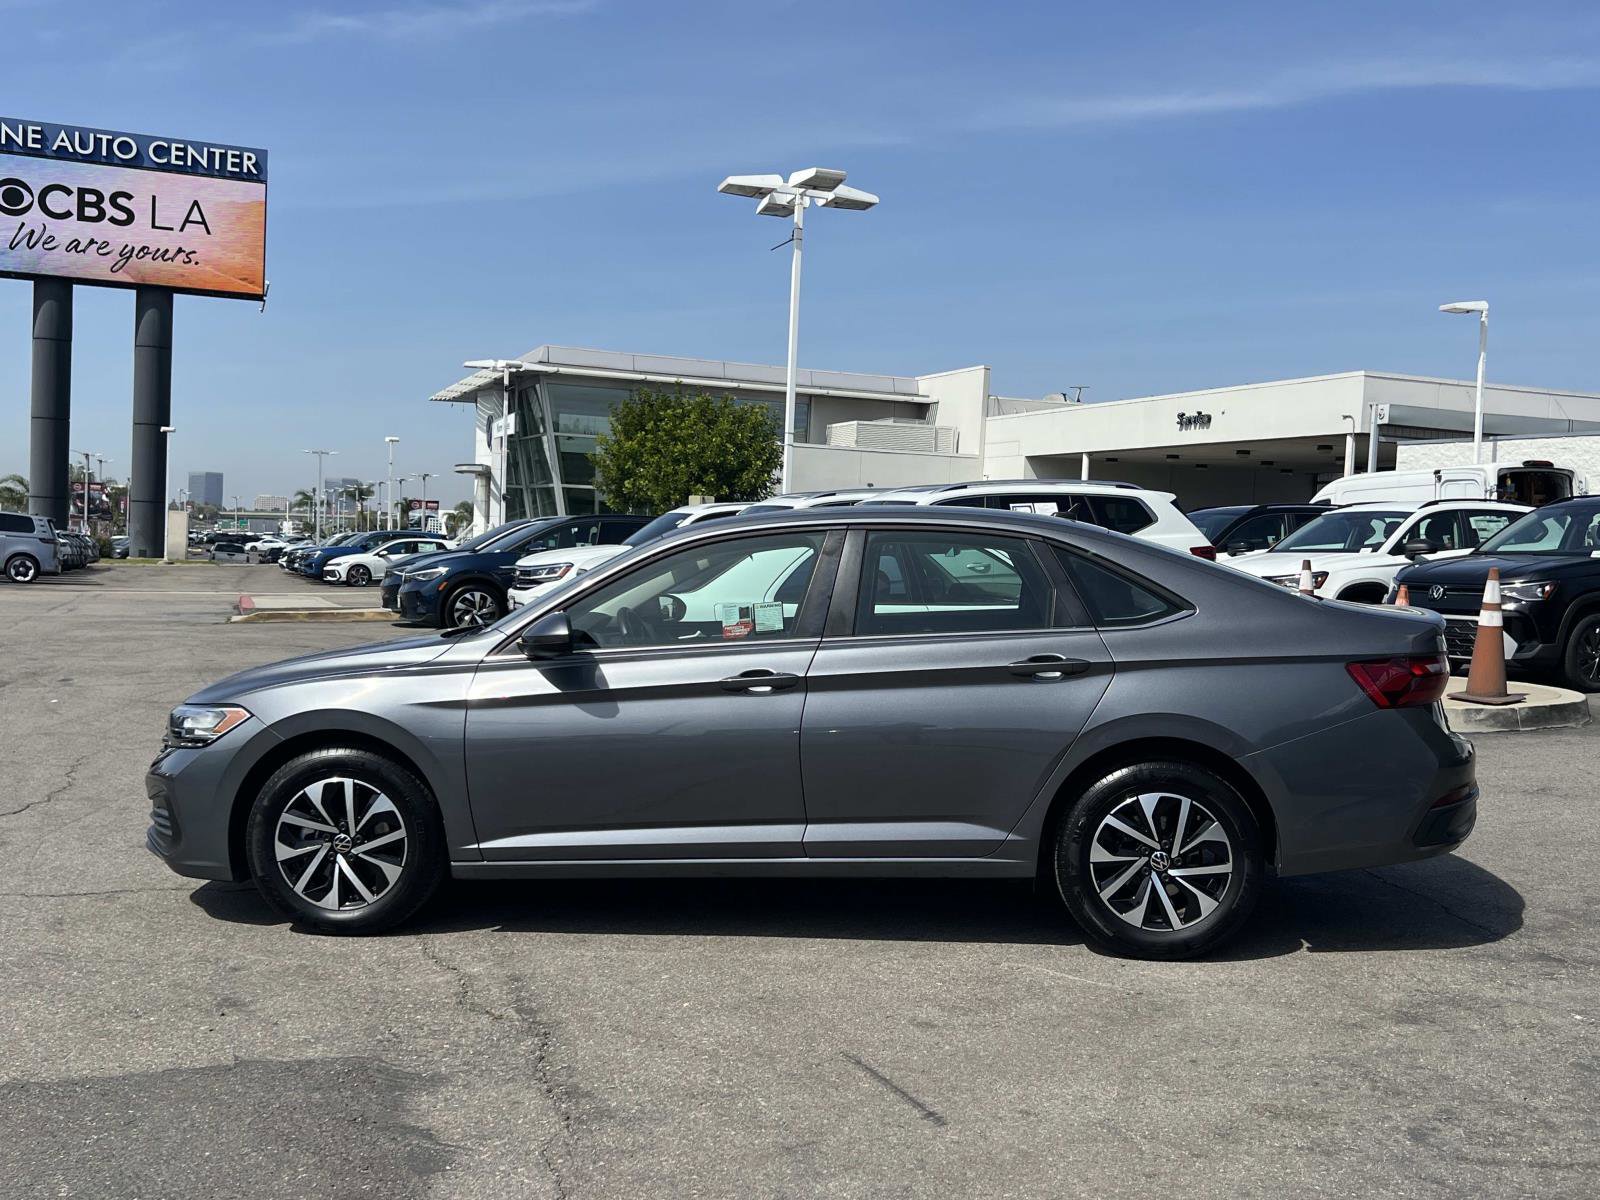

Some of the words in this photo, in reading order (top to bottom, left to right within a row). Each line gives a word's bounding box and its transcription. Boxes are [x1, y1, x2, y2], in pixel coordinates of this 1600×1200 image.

[0, 122, 43, 149] NE
[52, 129, 138, 160] AUTO
[148, 140, 259, 175] CENTER
[37, 183, 136, 227] CBS
[151, 194, 212, 236] LA
[8, 221, 60, 251] We
[65, 237, 115, 257] are
[110, 241, 200, 274] yours.
